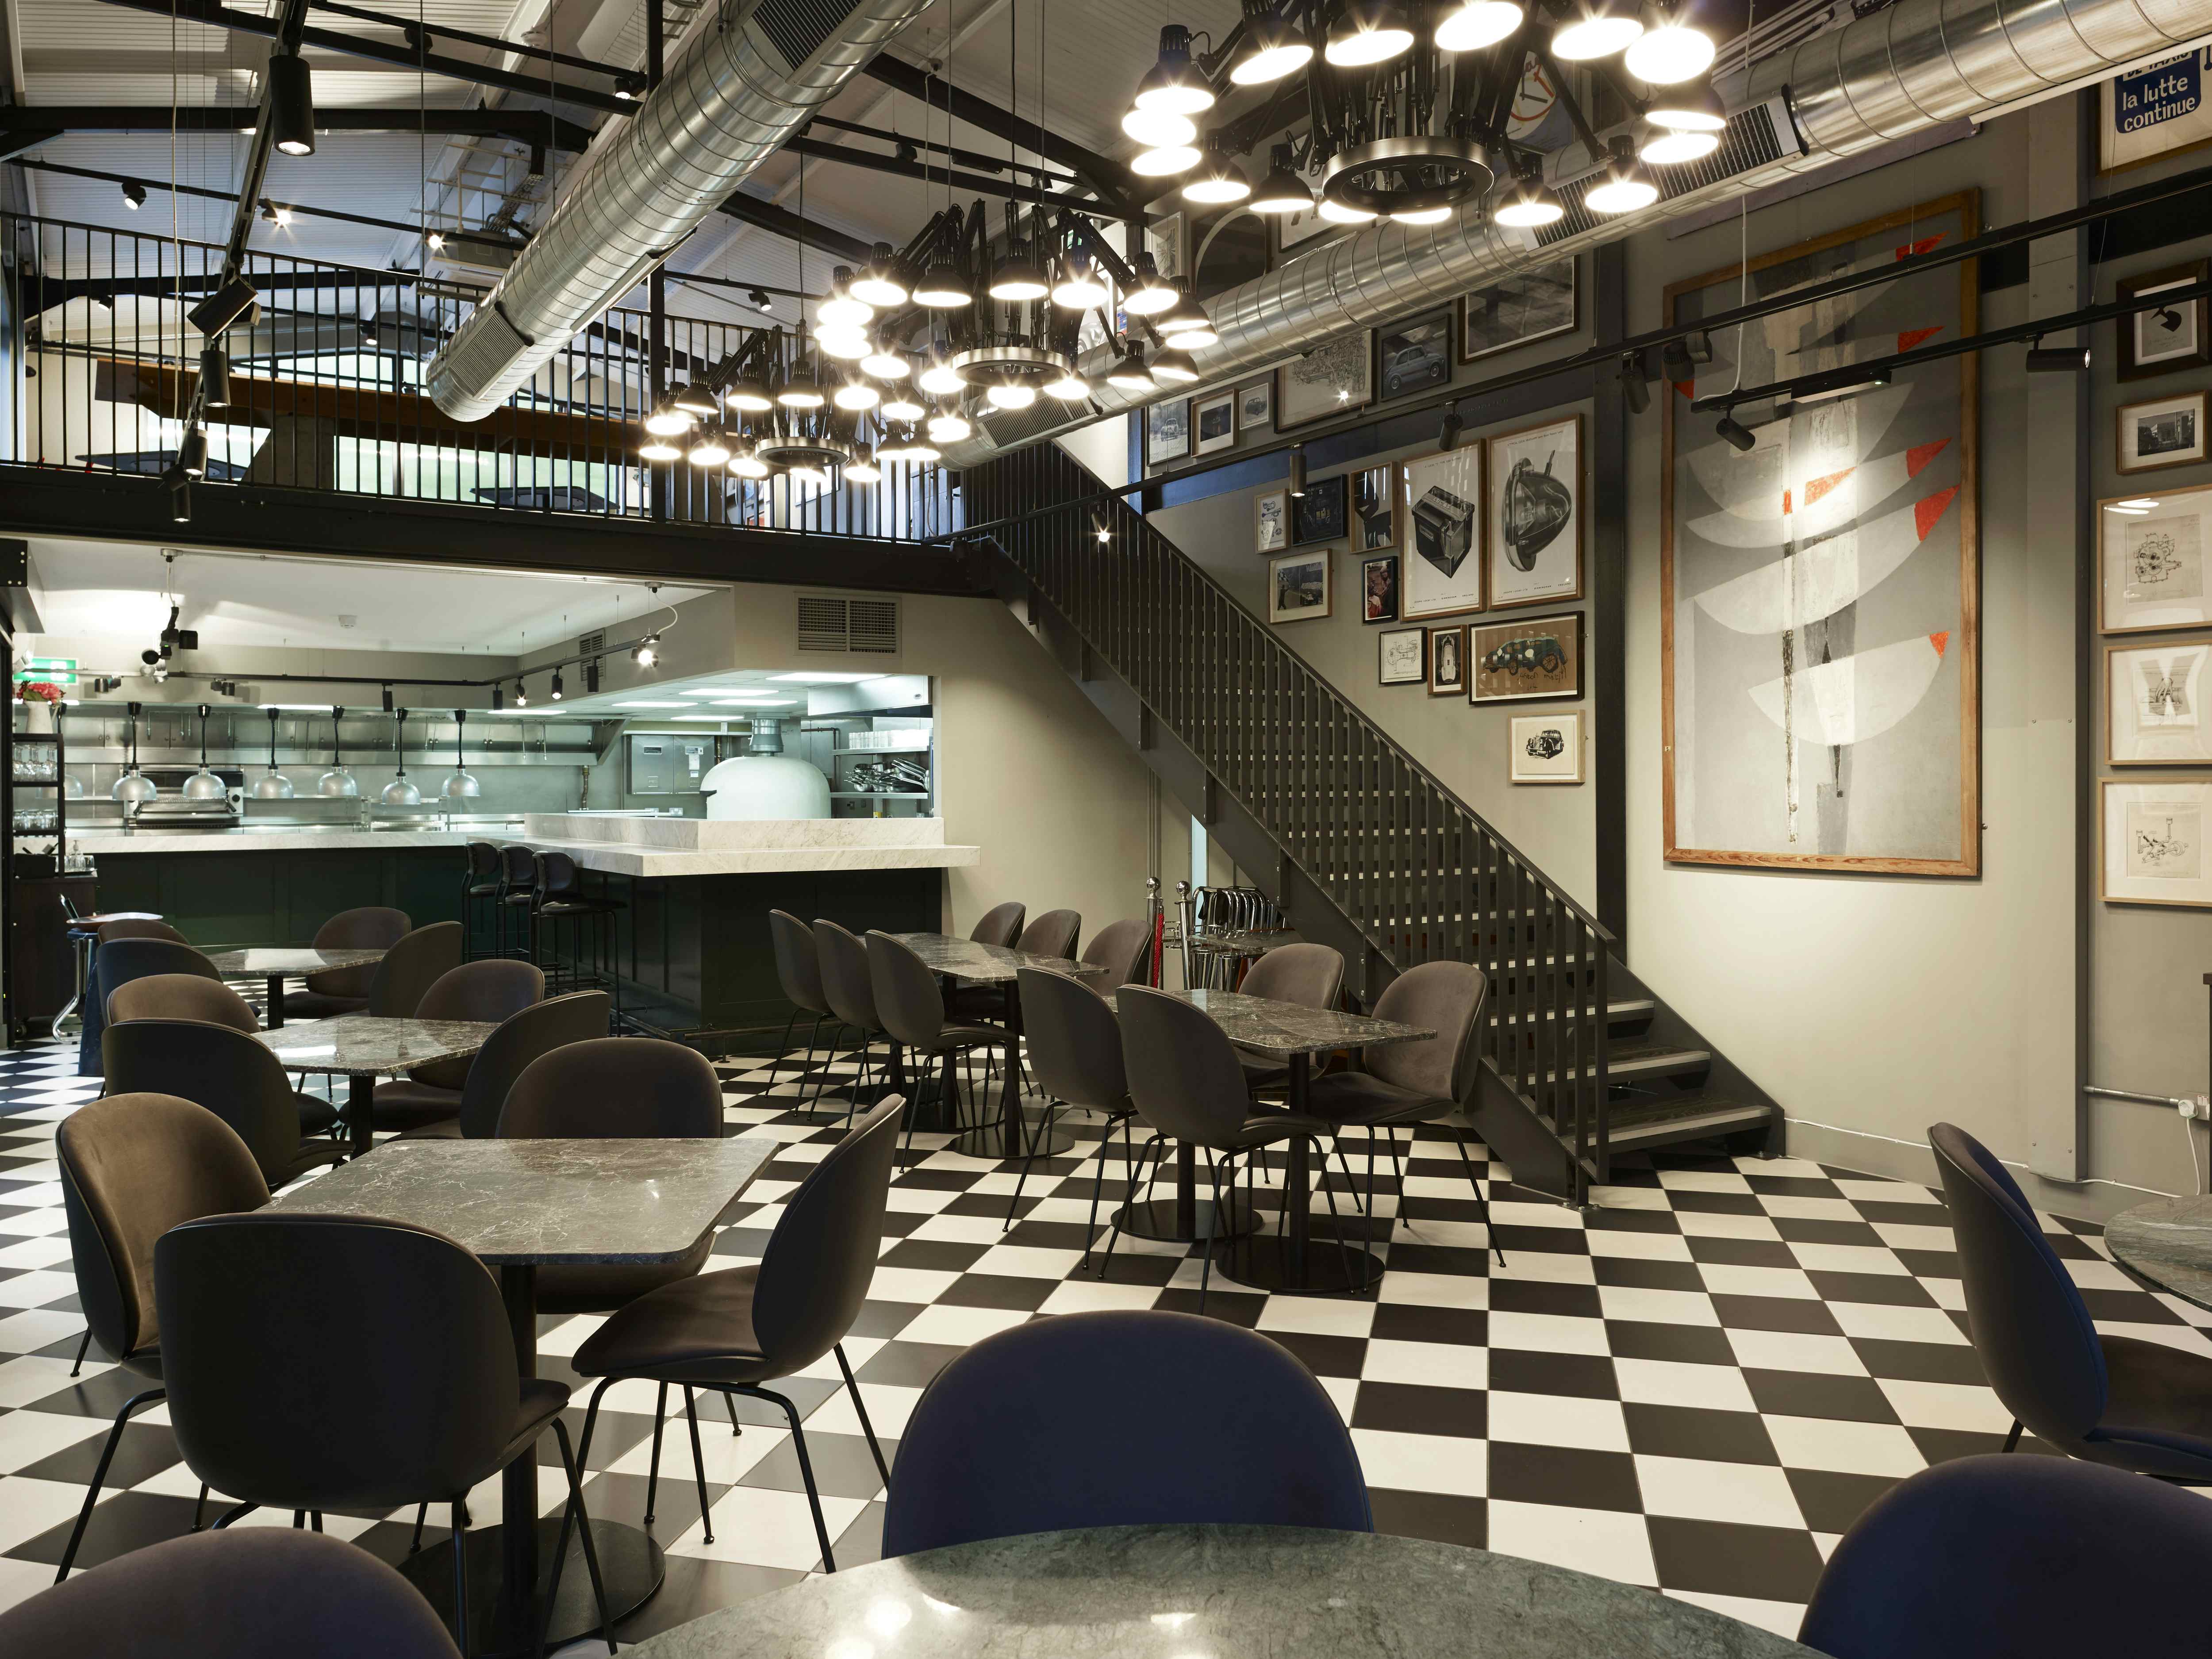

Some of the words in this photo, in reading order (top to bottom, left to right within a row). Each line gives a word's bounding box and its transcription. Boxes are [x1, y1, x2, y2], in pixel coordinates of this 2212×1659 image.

[2123, 92, 2138, 111] la
[2144, 75, 2188, 104] lutte
[2124, 97, 2195, 132] continue
[1433, 498, 1451, 509] LUCAS
